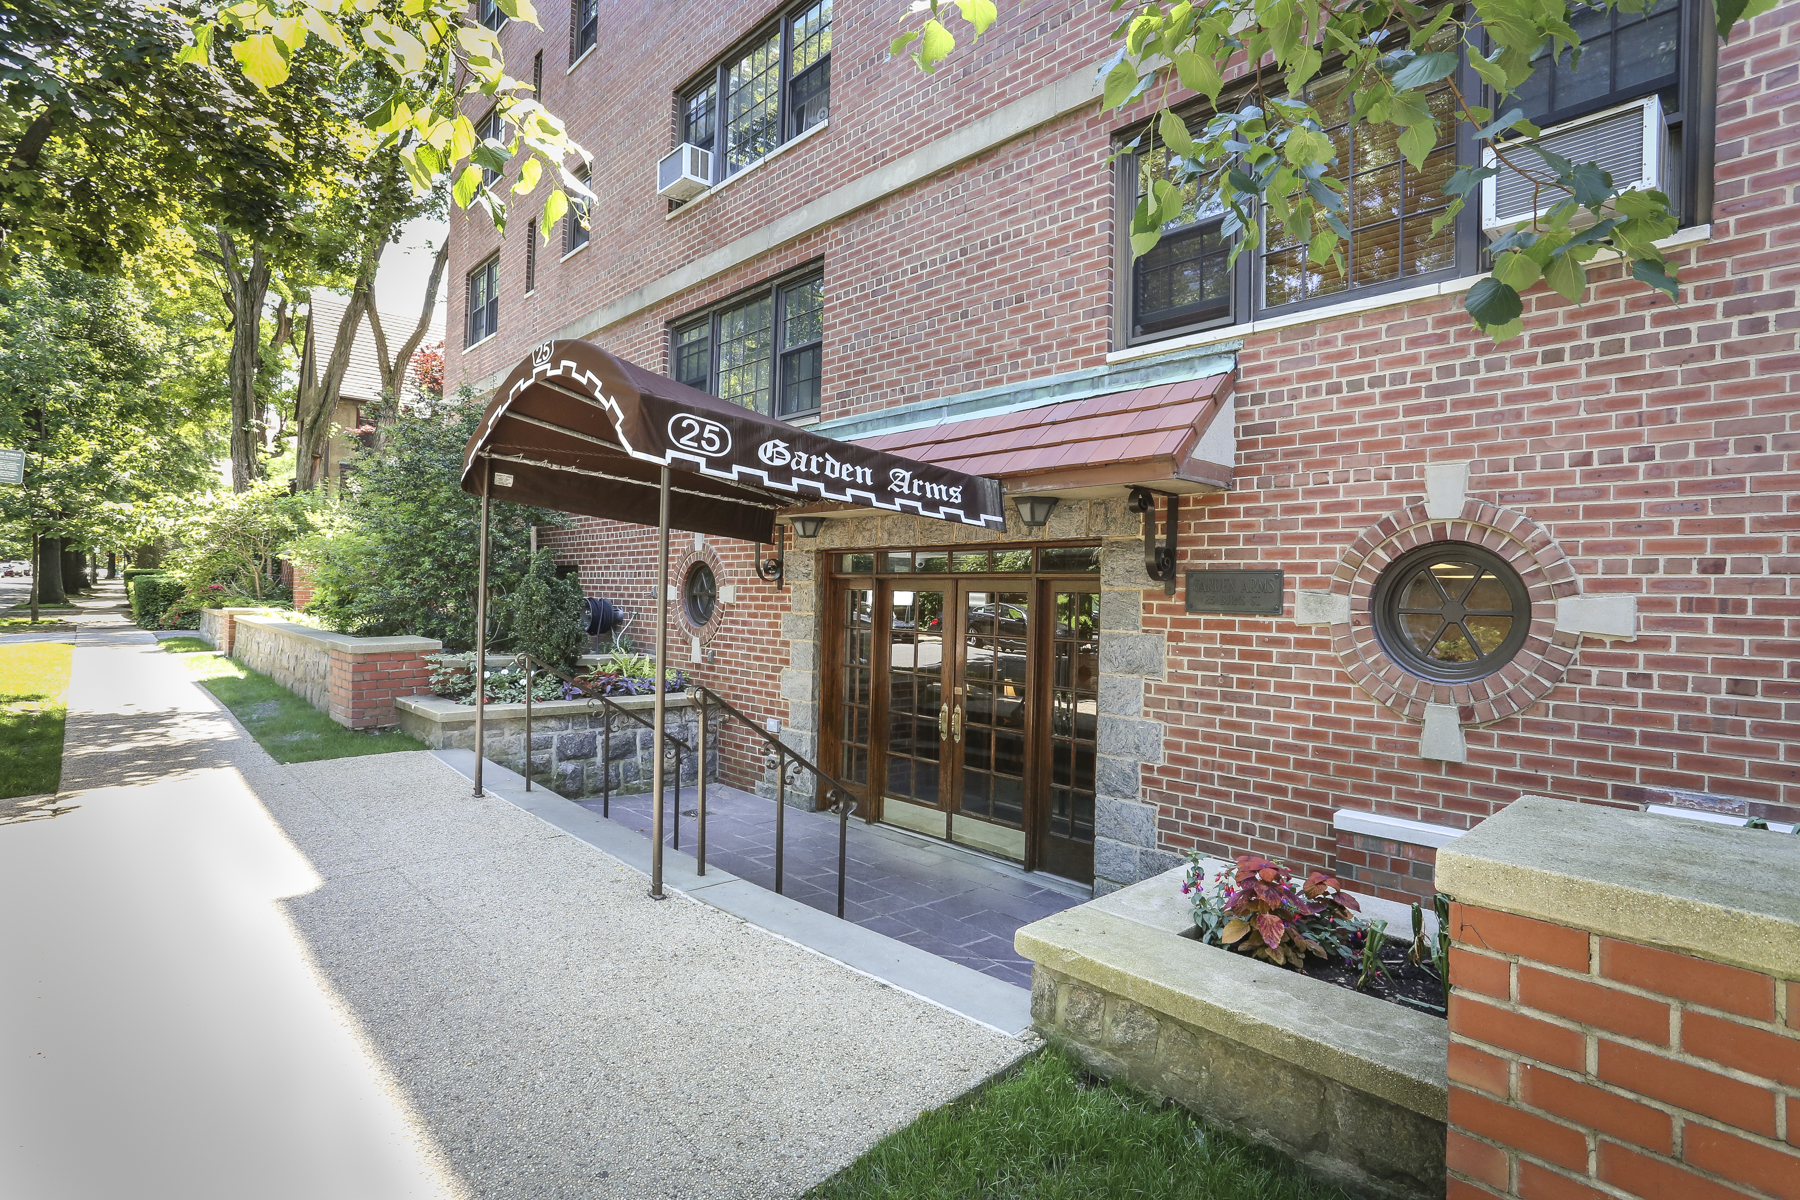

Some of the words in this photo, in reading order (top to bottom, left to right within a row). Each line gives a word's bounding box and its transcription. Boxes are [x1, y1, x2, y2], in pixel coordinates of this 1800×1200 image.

[535, 340, 550, 363] 25
[679, 419, 720, 451] 25
[758, 439, 873, 486] Garden
[887, 468, 963, 504] Arms
[1193, 578, 1236, 593] GARDEN
[1240, 578, 1275, 593] ARMS
[1204, 594, 1215, 605] 25
[1220, 594, 1246, 606] BURNS
